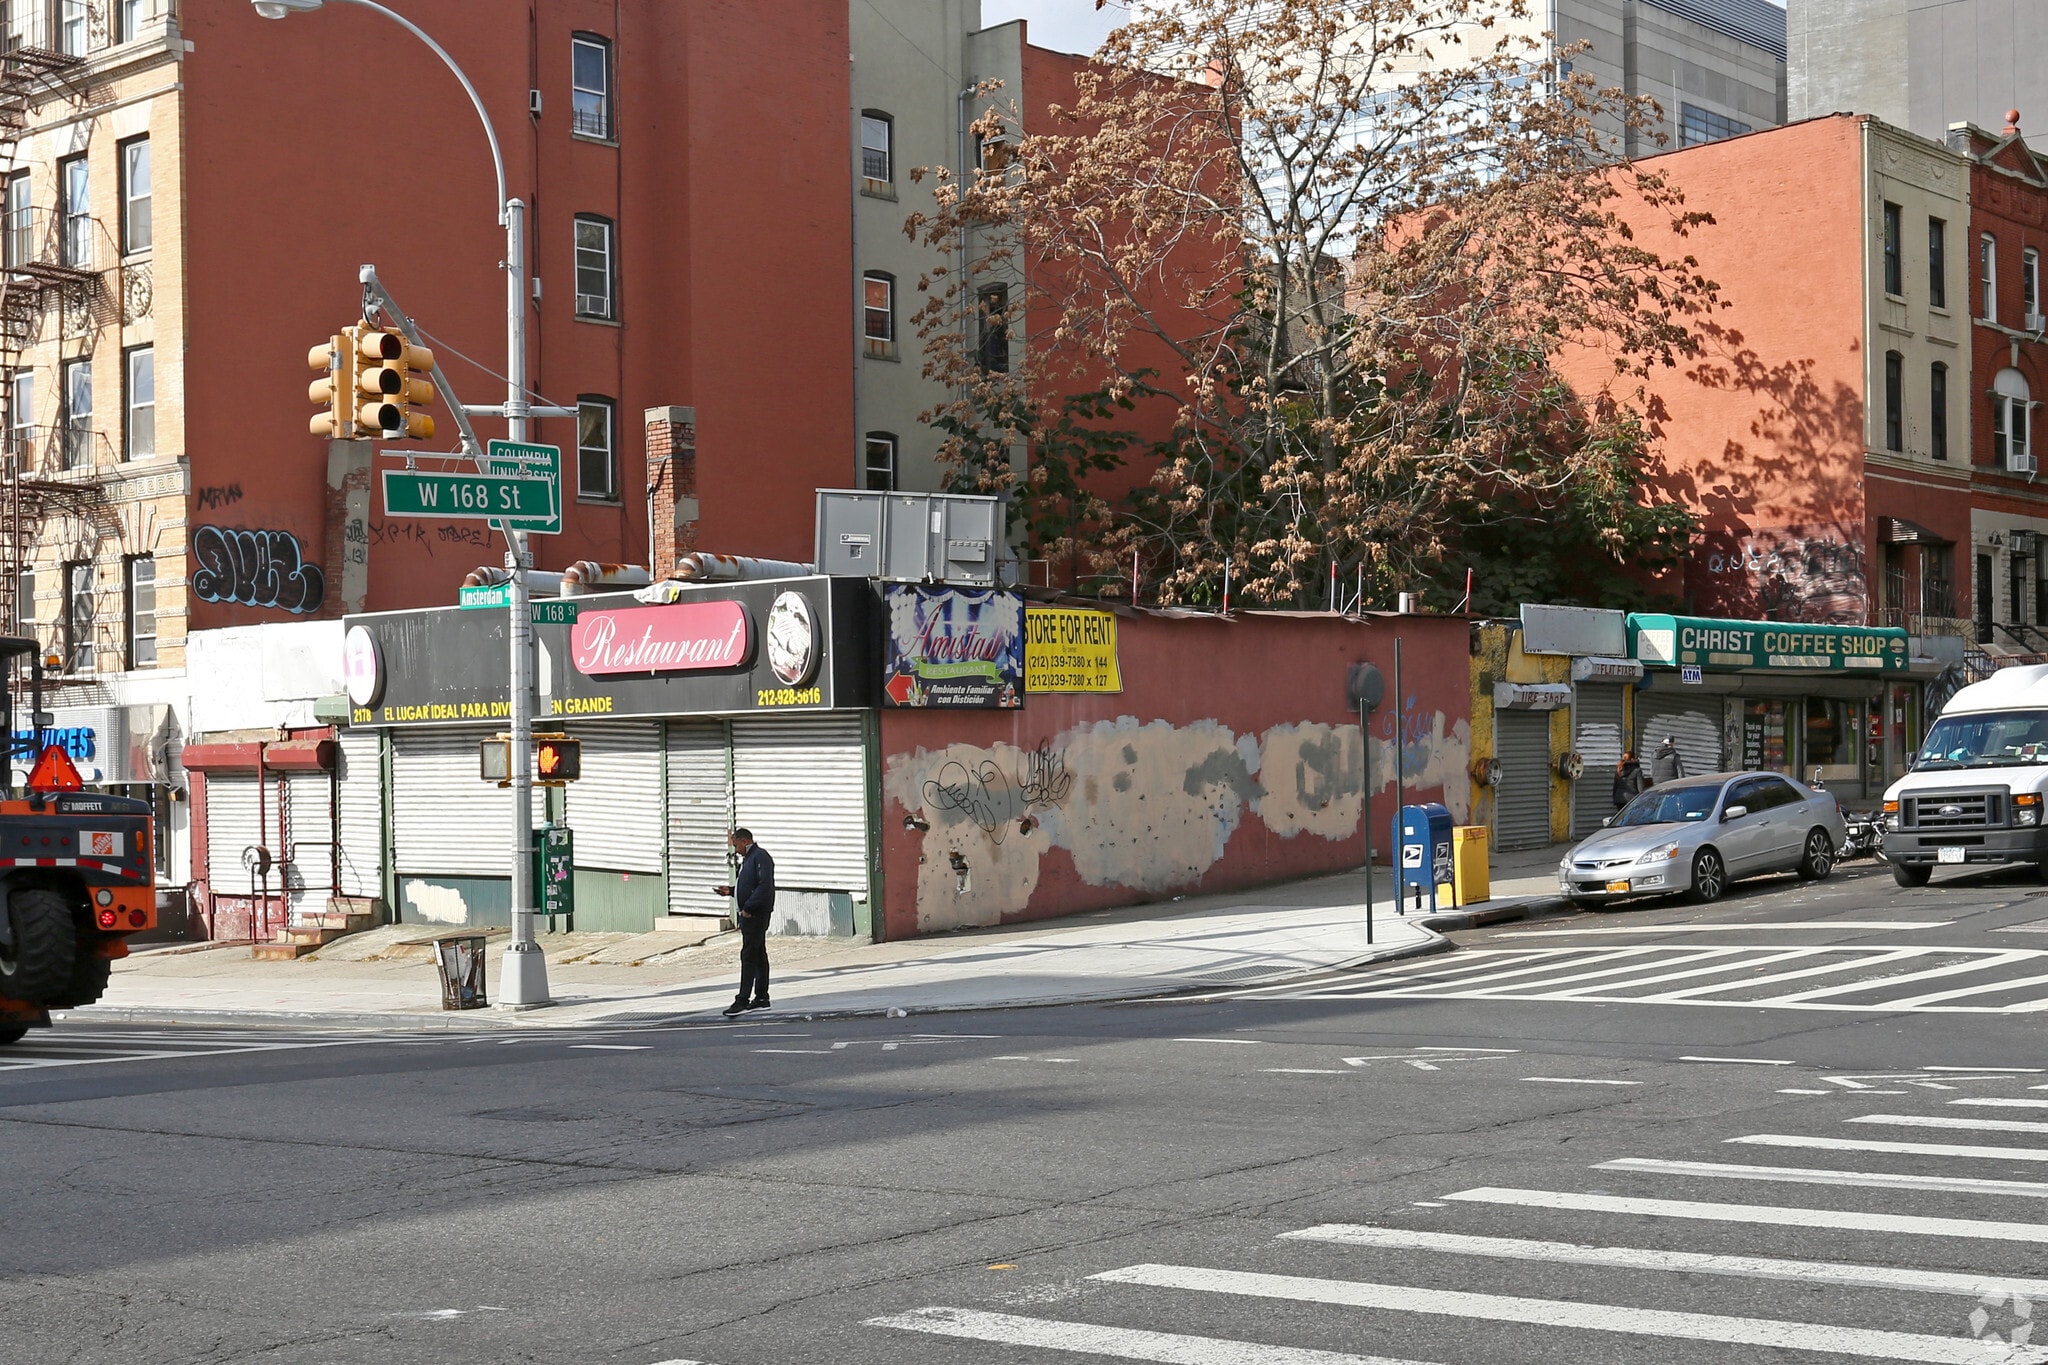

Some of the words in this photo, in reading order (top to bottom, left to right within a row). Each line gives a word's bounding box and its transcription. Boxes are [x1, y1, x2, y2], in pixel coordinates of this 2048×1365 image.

[418, 483, 438, 507] W
[450, 484, 489, 508] 168
[500, 485, 521, 510] St
[461, 589, 503, 607] Amsterdam
[505, 589, 511, 598] A
[532, 606, 541, 621] W
[546, 606, 564, 622] 168
[568, 607, 576, 616] St
[899, 602, 1004, 660] Amistad
[1059, 614, 1082, 645] FOR
[1084, 615, 1111, 645] RENT
[1640, 631, 1671, 644] COFFEE
[578, 615, 743, 669] Restaurant
[1681, 627, 1755, 651] CHRIST
[1763, 631, 1836, 654] COFFEE
[1841, 635, 1887, 655] SHOP
[1645, 643, 1669, 656] SHOP
[926, 664, 988, 676] RESTAURANT
[1028, 655, 1049, 671] (212)
[1086, 659, 1091, 668] x
[1095, 656, 1108, 668] 144
[1086, 678, 1092, 686] x
[1095, 675, 1108, 687] 127
[1683, 670, 1701, 681] ATM
[757, 688, 821, 706] 212-928-5616
[930, 684, 966, 694] Ambiente
[966, 684, 996, 695] Familiar
[937, 696, 952, 704] con
[353, 708, 372, 723] 2178
[384, 707, 395, 721] EL
[396, 705, 430, 721] LUGAR
[431, 703, 459, 720] IDEAL
[461, 703, 489, 718] PARA
[565, 697, 612, 714] GRANDE
[71, 802, 102, 811] MOFFETT
